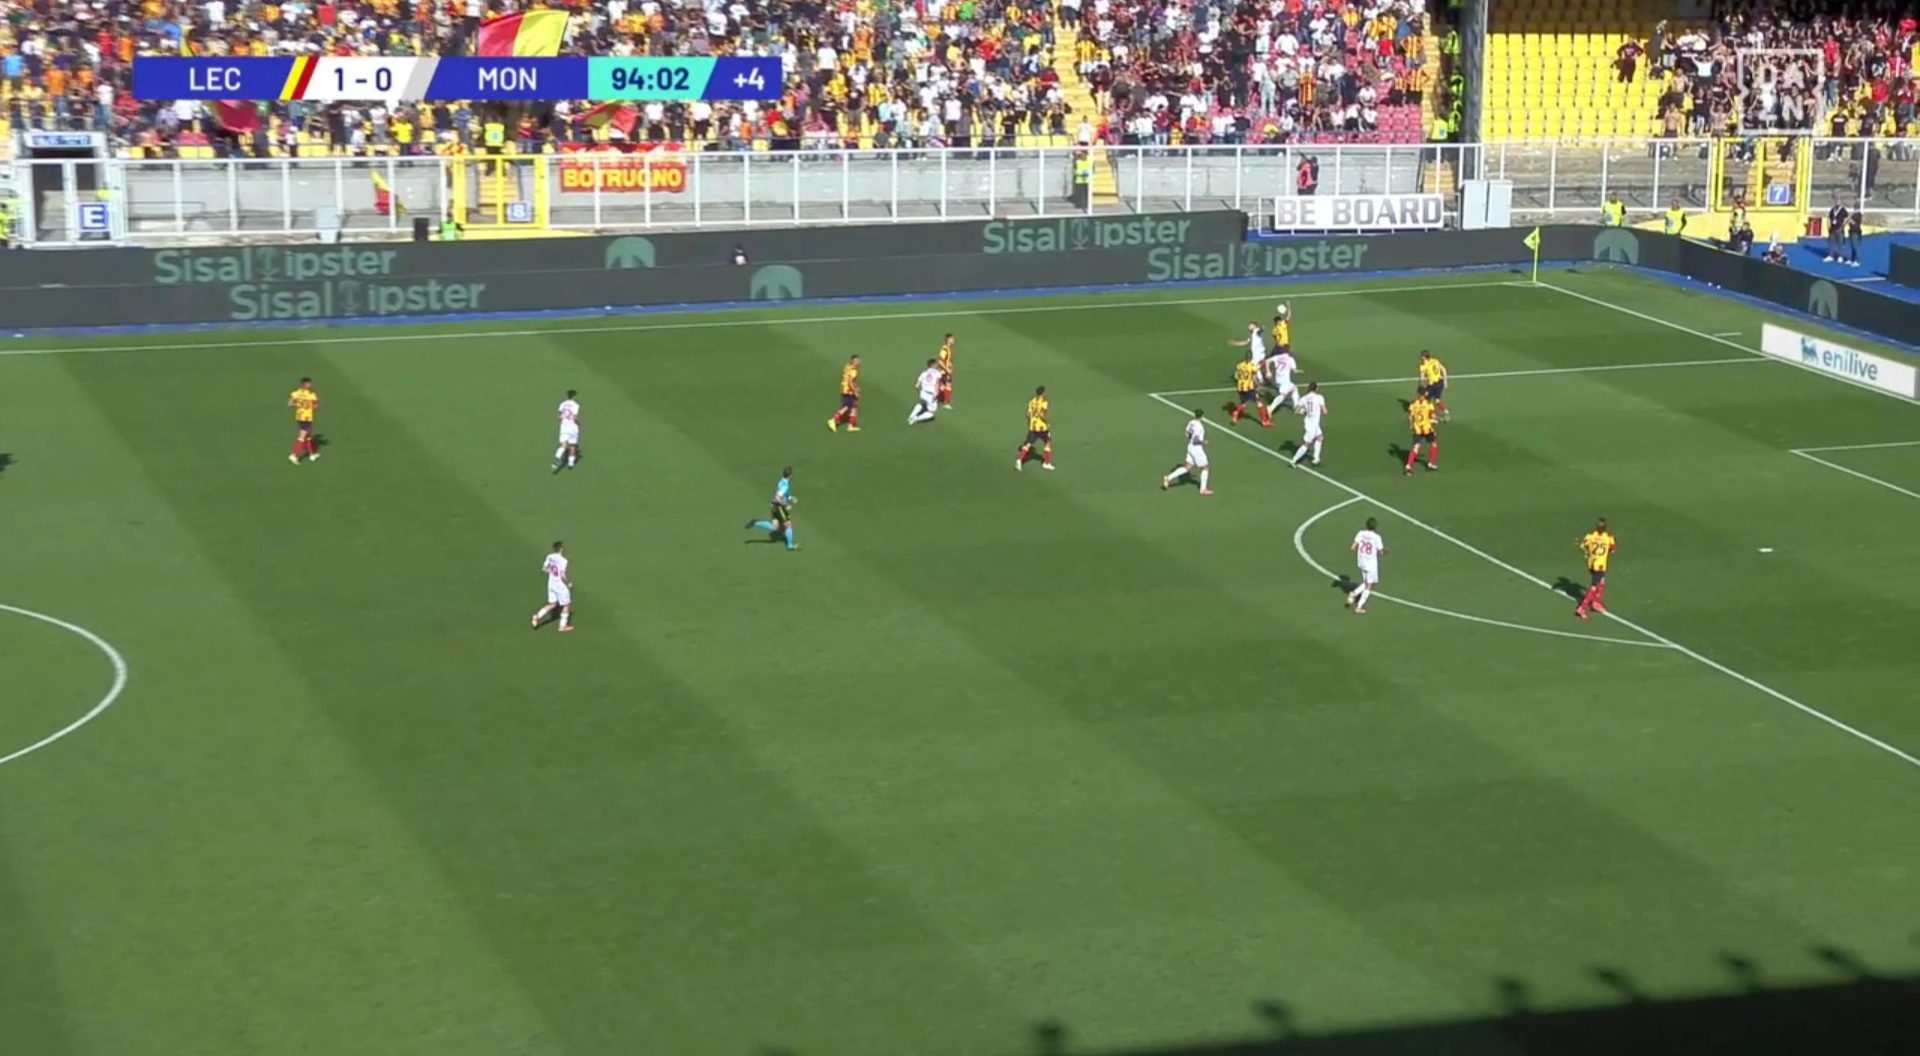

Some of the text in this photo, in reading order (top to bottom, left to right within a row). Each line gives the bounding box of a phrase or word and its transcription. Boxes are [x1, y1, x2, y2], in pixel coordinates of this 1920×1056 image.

[563, 168, 682, 188] BOTRUGNO
[1773, 187, 1785, 201] 7
[83, 206, 105, 228] E
[1278, 197, 1442, 225] BE BOARD
[982, 219, 1066, 254] Sisal
[153, 248, 251, 283] Sisal
[1147, 243, 1235, 281] Sisal
[231, 281, 333, 320] Sisal
[1823, 350, 1878, 380] enilive
[1360, 540, 1373, 555] 28
[1592, 542, 1606, 556] 25
